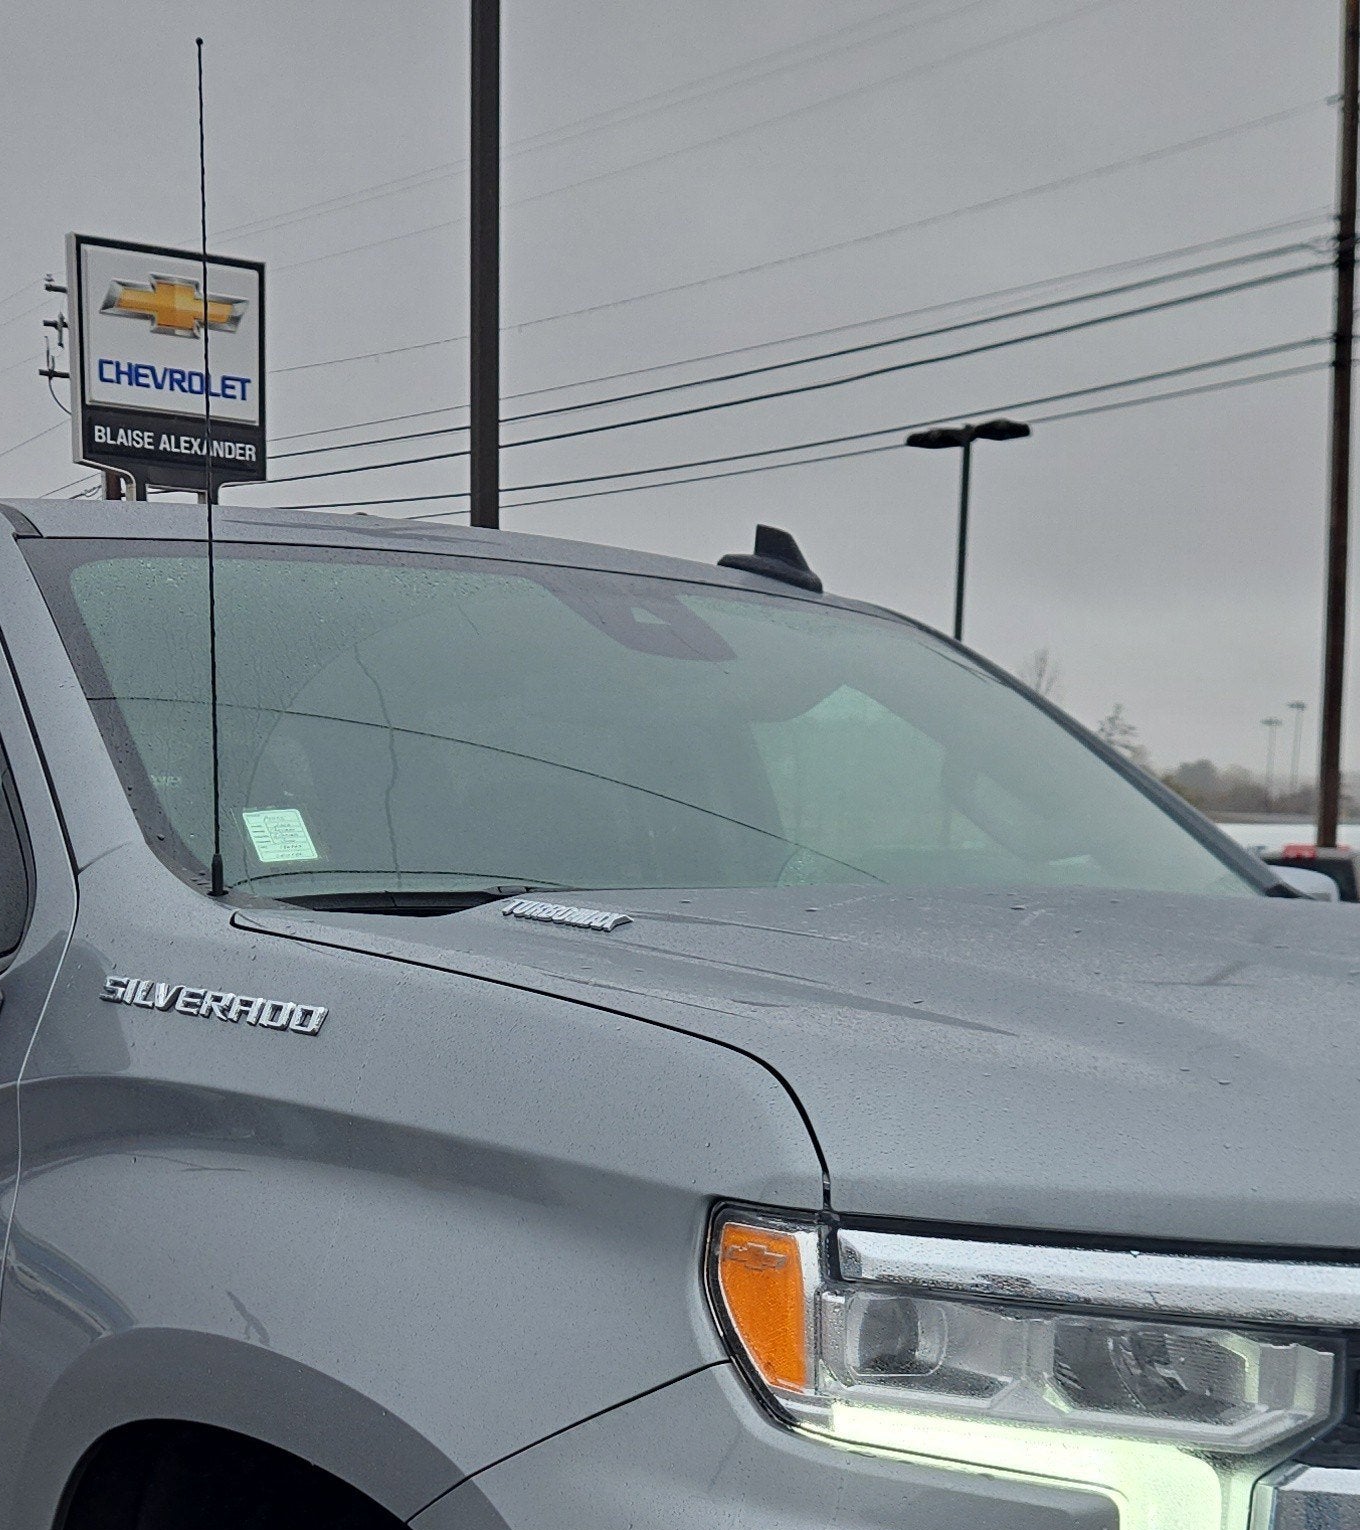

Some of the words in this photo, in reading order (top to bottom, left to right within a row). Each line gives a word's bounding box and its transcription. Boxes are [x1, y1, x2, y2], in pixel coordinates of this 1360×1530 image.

[98, 358, 252, 401] CHEVROLET
[94, 425, 155, 450] BLAISE
[159, 434, 257, 462] ALEXANDER
[99, 975, 330, 1036] SILVERADO
